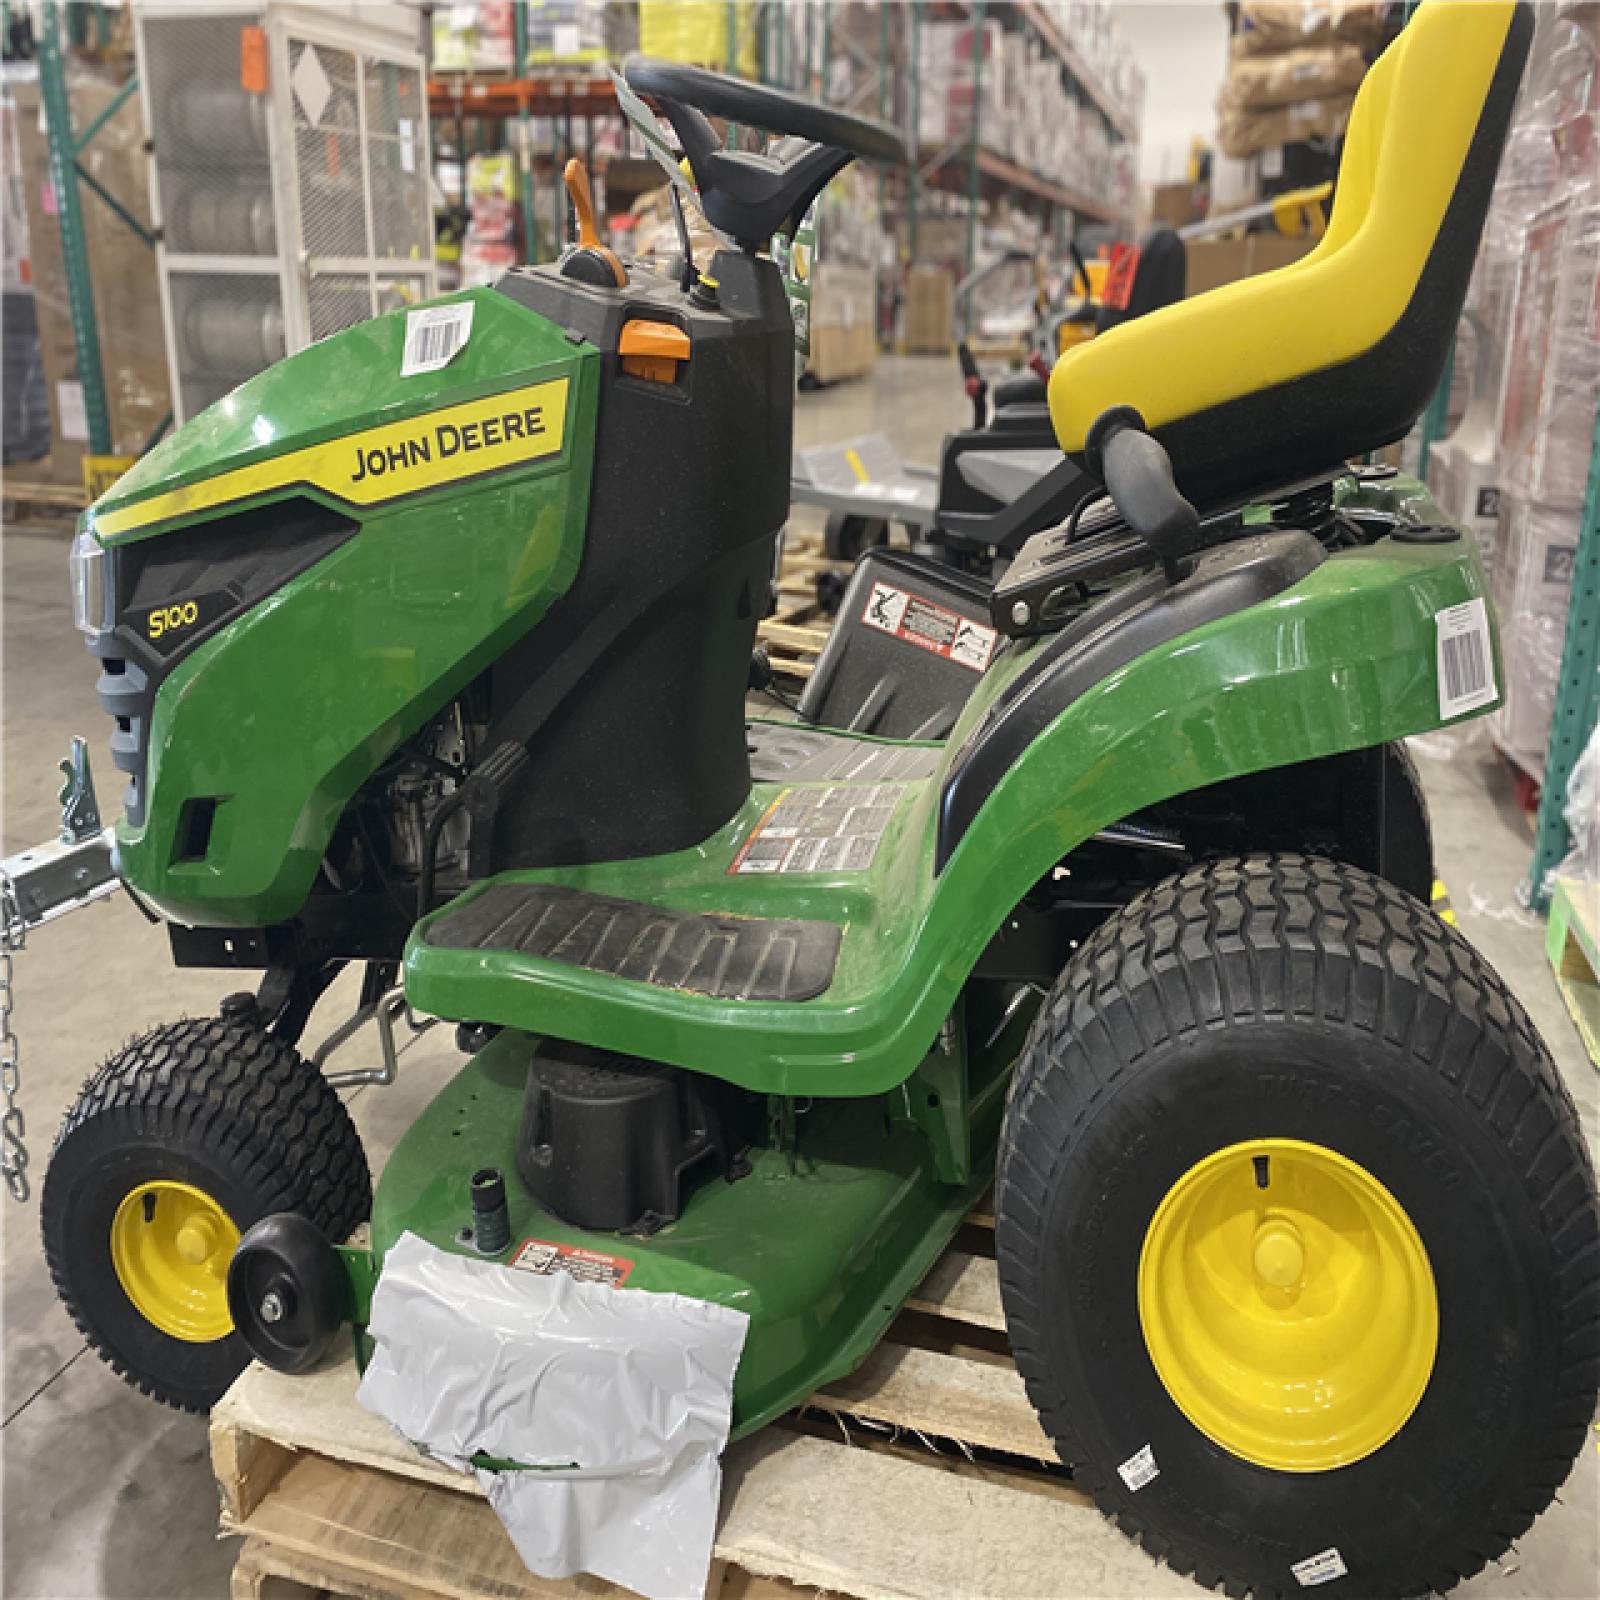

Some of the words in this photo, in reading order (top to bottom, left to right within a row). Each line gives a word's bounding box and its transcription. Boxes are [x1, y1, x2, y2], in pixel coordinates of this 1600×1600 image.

[352, 436, 431, 482] JOHN
[435, 407, 545, 458] DEERE
[149, 601, 199, 638] S100
